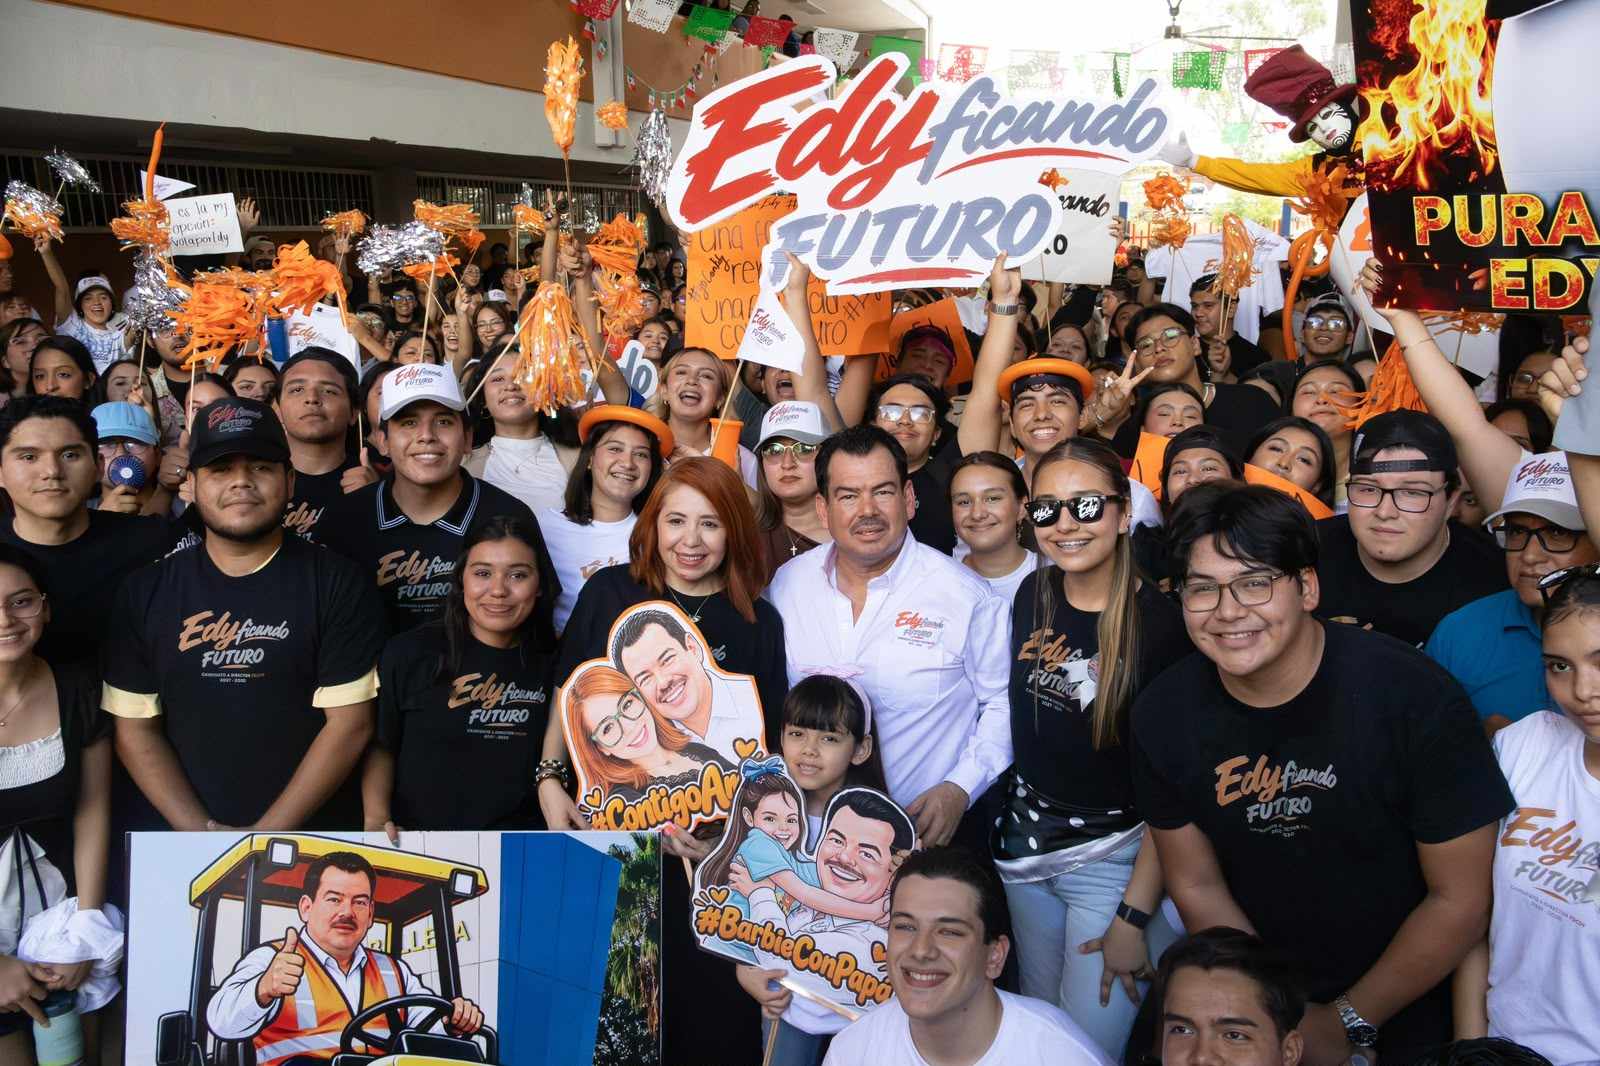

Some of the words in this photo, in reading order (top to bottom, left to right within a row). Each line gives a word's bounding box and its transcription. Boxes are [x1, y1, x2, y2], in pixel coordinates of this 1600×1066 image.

[680, 57, 1168, 224] Edyficando
[1413, 191, 1600, 247] PURA
[767, 194, 1053, 288] FUTURO
[1077, 497, 1099, 519] Edy
[178, 610, 290, 652] Edyficando
[201, 648, 265, 668] FUTURO
[468, 709, 529, 725] FUTURO
